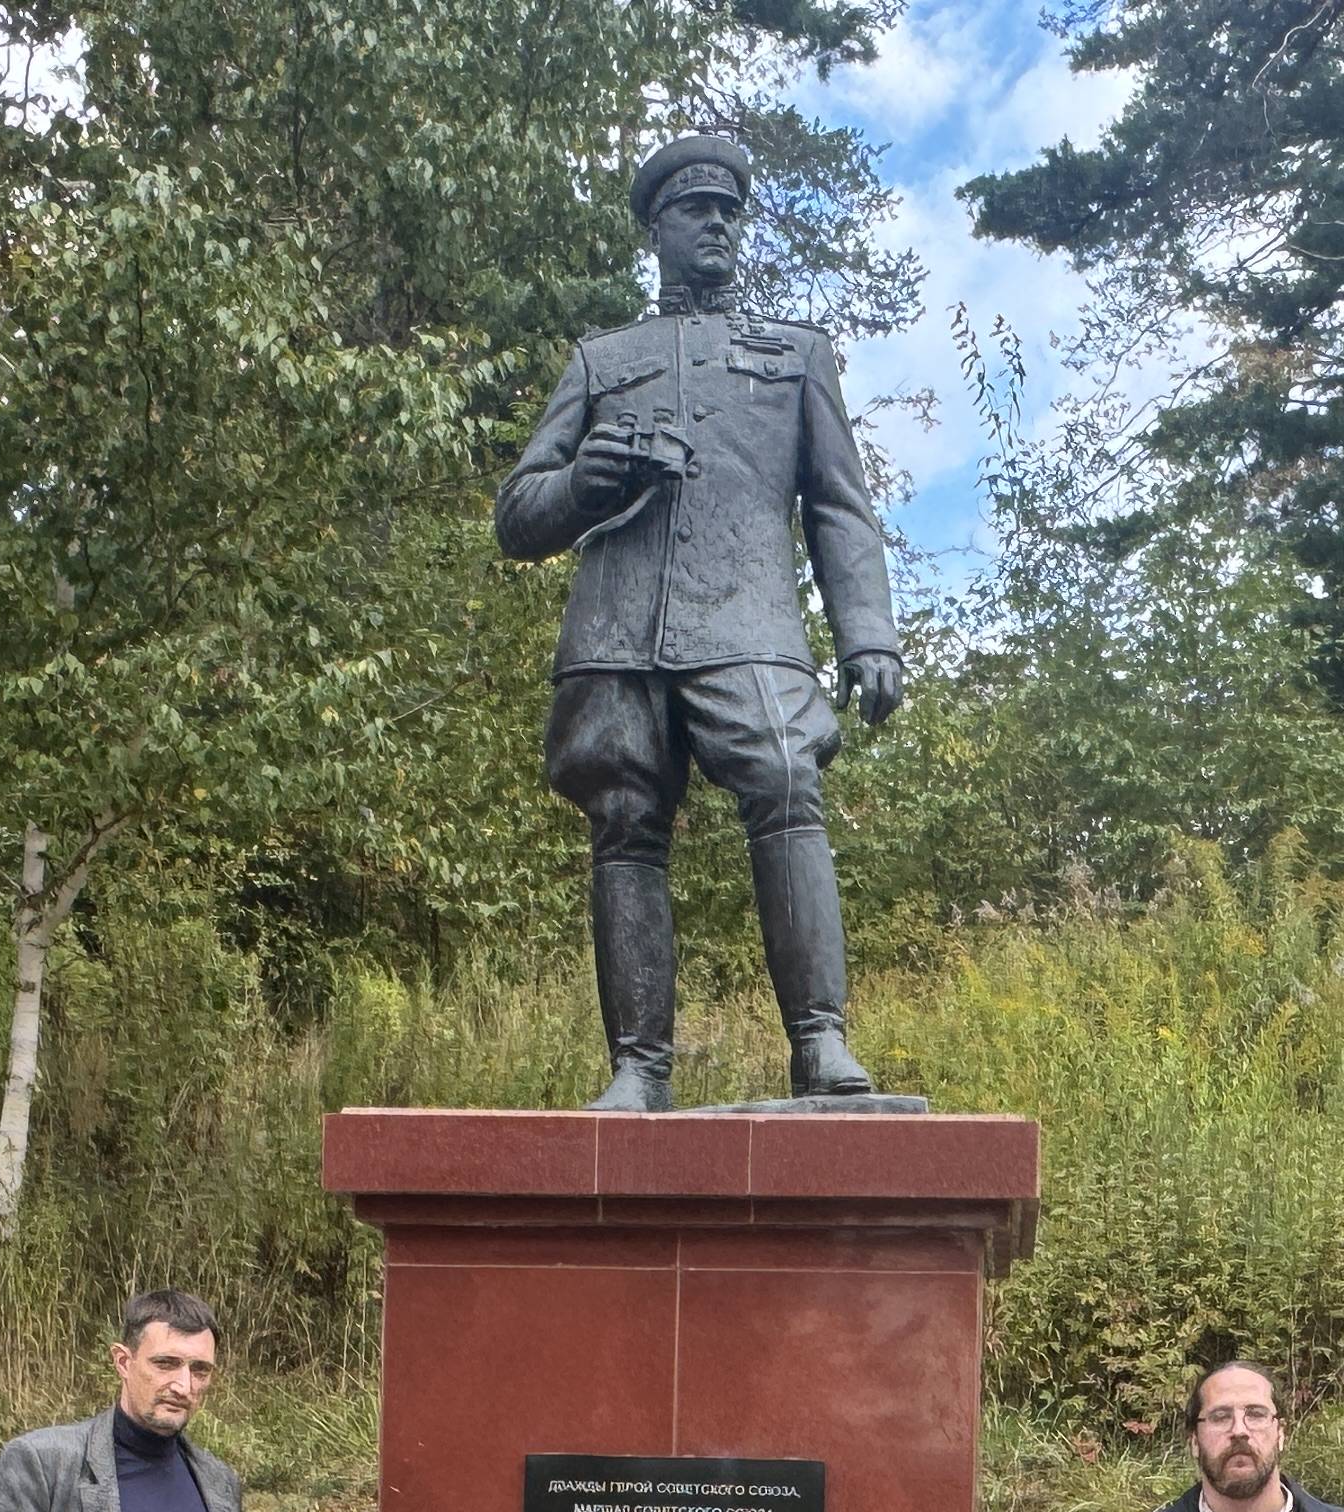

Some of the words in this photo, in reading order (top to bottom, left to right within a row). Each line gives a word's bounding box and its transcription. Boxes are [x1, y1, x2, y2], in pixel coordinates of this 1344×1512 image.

[548, 1480, 606, 1493] ДВАЖДЫ
[610, 1480, 653, 1493] ГЕРОЙ
[657, 1482, 745, 1496] СОВЕТСКОГО
